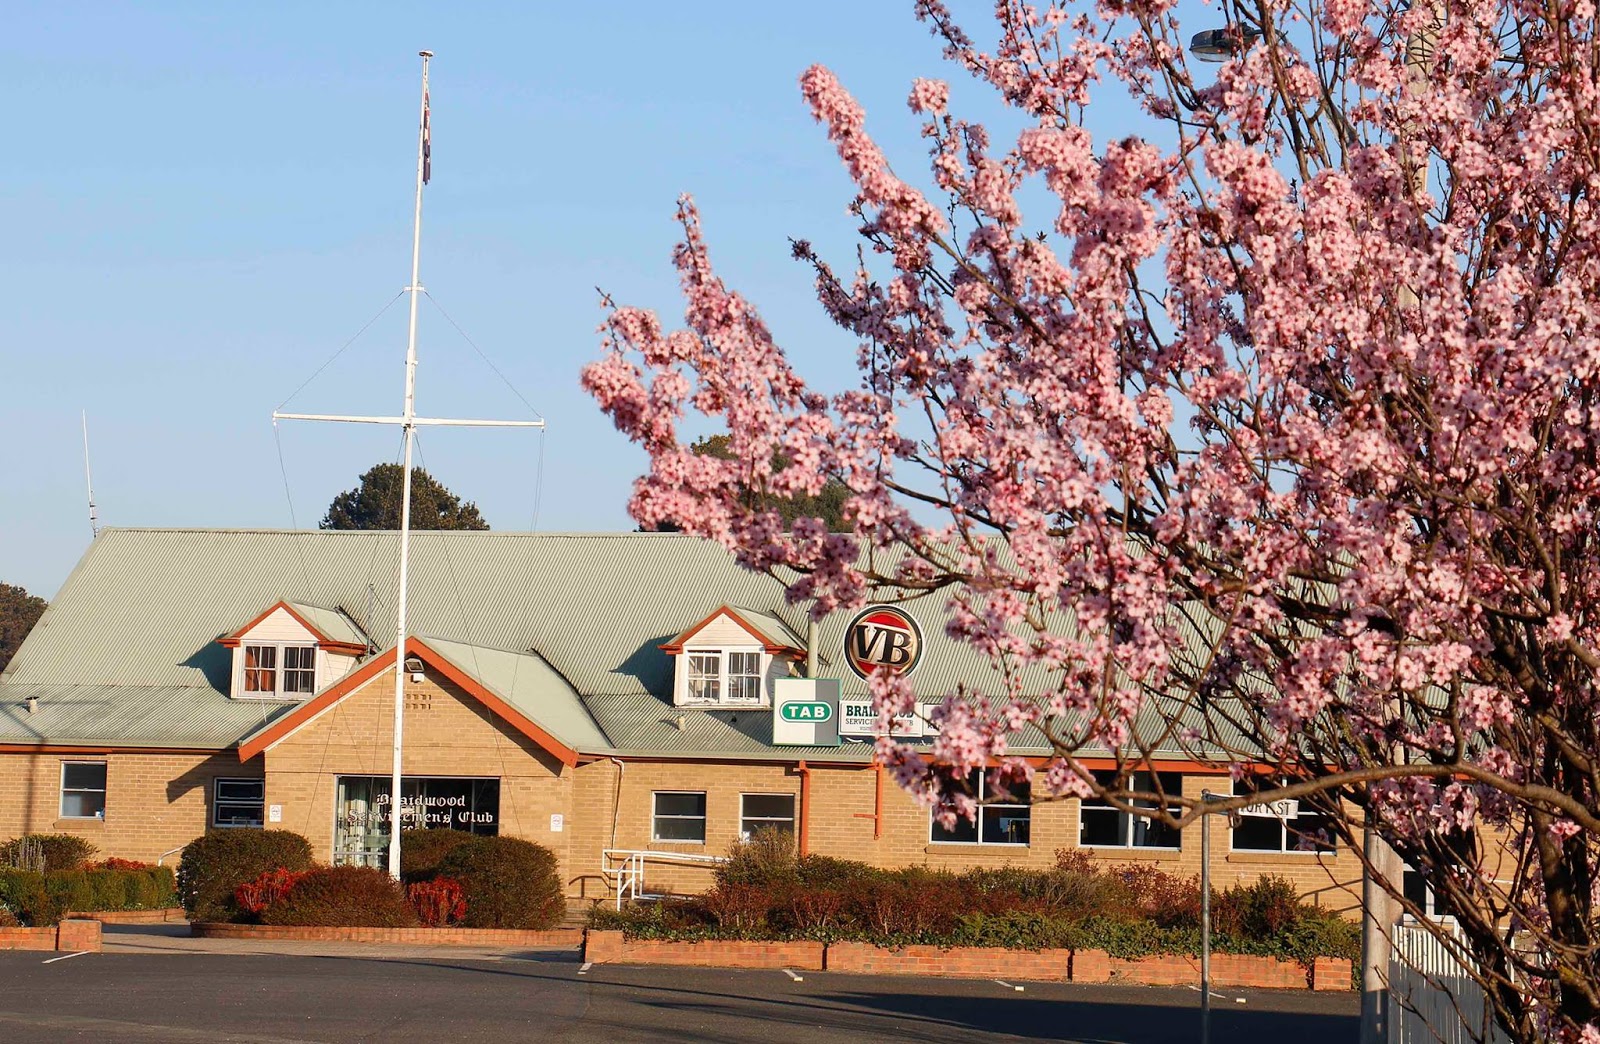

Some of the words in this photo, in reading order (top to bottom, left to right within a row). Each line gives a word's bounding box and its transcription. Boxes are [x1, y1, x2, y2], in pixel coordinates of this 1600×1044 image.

[855, 624, 913, 665] VB
[788, 705, 825, 718] TAB
[846, 705, 914, 718] BRAIDOD
[376, 793, 466, 807] Baidwood
[1276, 801, 1291, 815] ST
[347, 809, 450, 824] Serviemen's
[458, 811, 493, 823] Club
